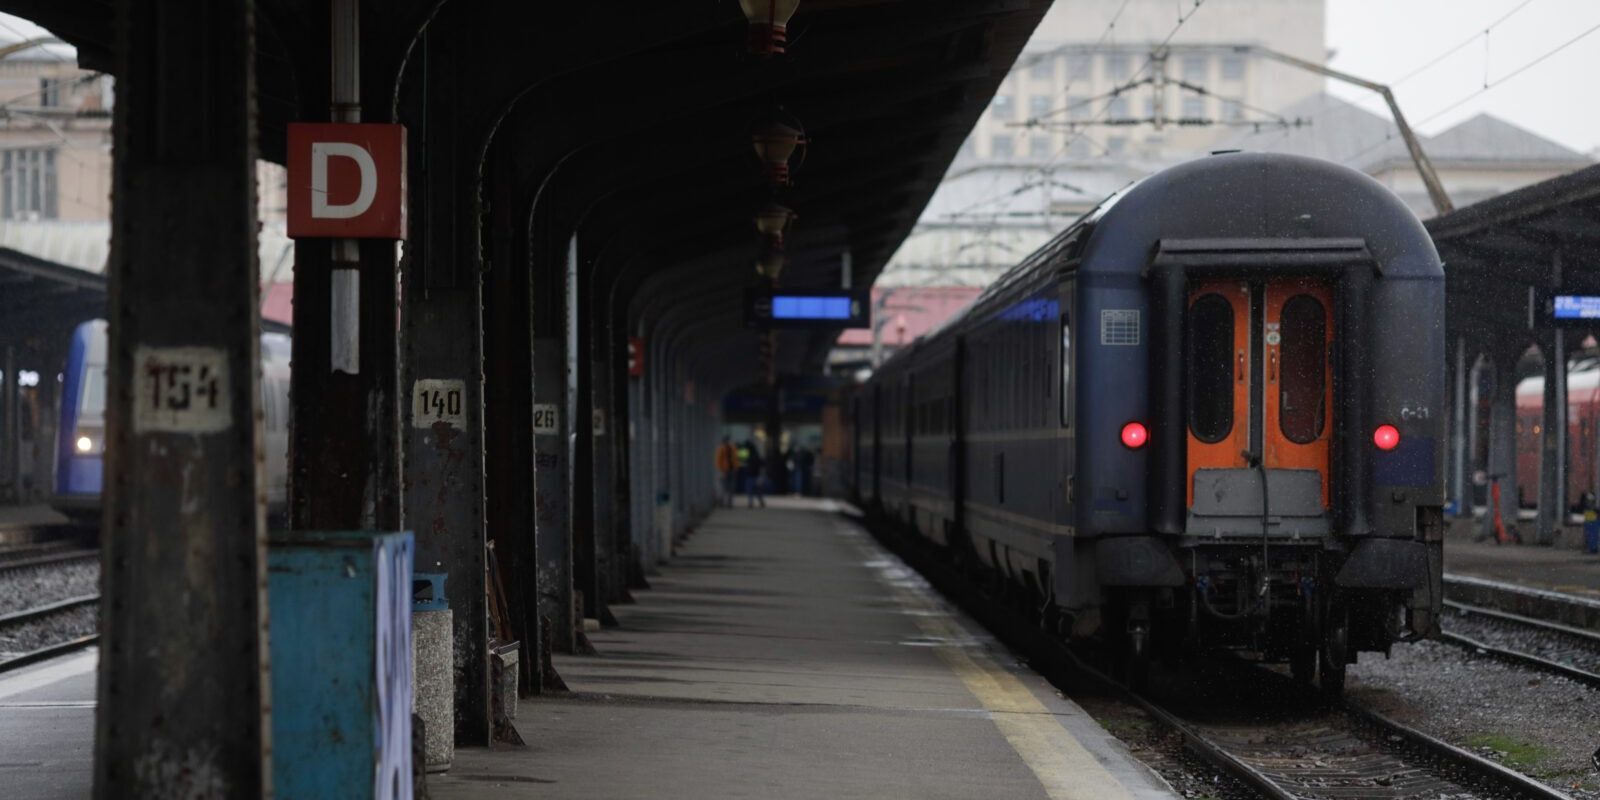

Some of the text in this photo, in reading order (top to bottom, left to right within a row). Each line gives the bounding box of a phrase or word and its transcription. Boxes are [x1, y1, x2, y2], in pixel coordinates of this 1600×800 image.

[311, 141, 378, 219] D
[146, 364, 217, 410] 154
[420, 390, 461, 416] 140
